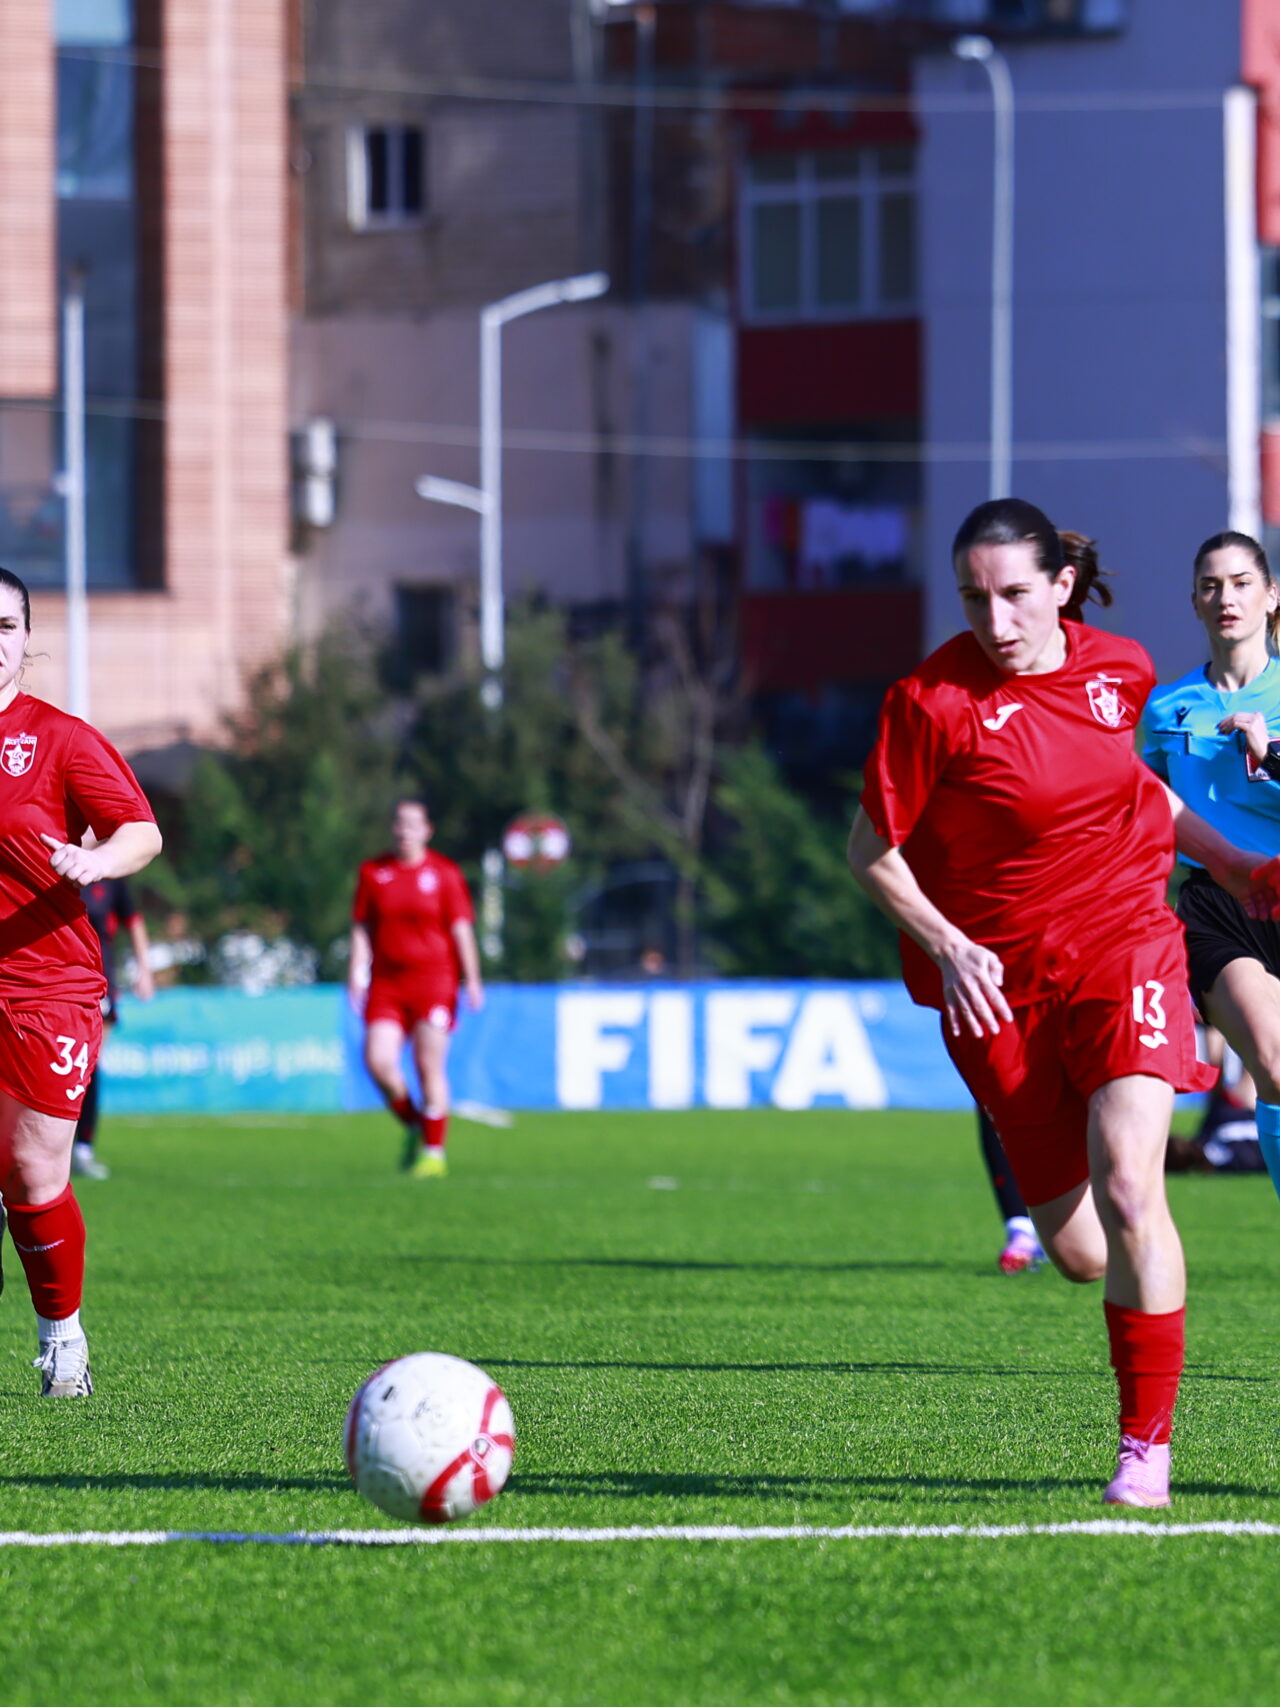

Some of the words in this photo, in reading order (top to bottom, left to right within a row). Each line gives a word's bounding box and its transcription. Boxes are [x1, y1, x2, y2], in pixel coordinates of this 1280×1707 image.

[1132, 980, 1167, 1029] 13
[50, 1035, 89, 1080] 34
[555, 991, 888, 1110] FIFA
